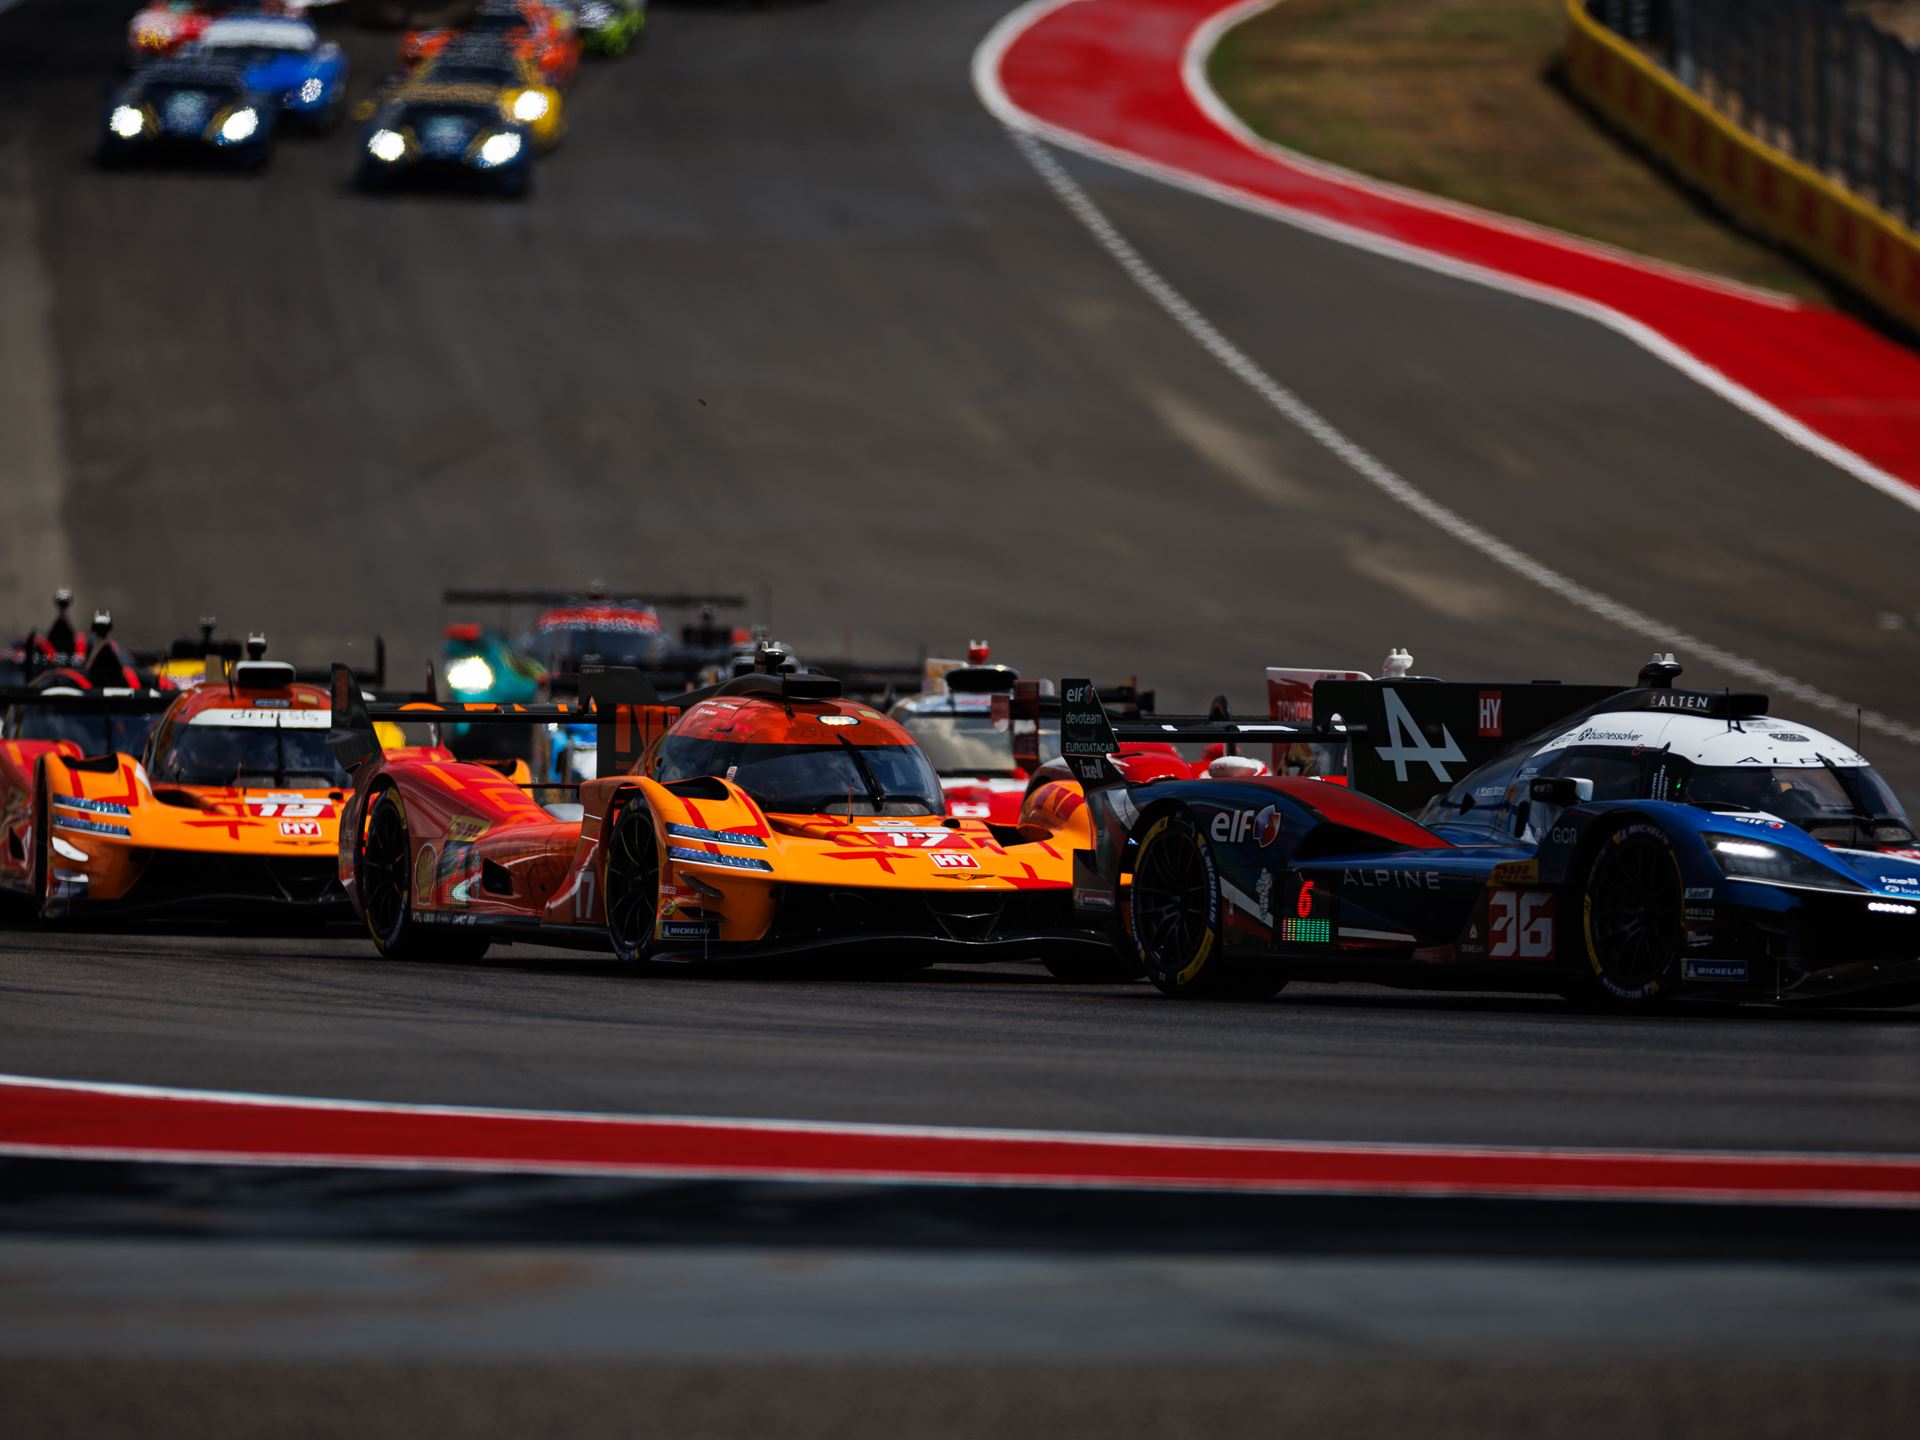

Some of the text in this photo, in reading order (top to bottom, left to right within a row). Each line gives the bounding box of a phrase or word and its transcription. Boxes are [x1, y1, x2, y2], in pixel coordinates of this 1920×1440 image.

[1066, 687, 1084, 703] elf
[1659, 695, 1708, 708] ALTEN
[1066, 712, 1103, 725] devoteam
[1480, 699, 1500, 729] HY
[1065, 742, 1115, 752] EURODATACAR
[1079, 758, 1105, 779] ixell
[282, 822, 315, 834] HY
[1210, 809, 1256, 843] elf
[887, 833, 949, 847] 17
[1552, 827, 1578, 845] GCR
[932, 854, 971, 867] HY
[1343, 868, 1441, 890] ALPINE
[575, 870, 596, 919] 17
[1202, 854, 1217, 925] MICHELIN
[670, 927, 711, 935] MICHELIN
[1488, 891, 1553, 958] 36
[1696, 966, 1746, 976] MICHELIN
